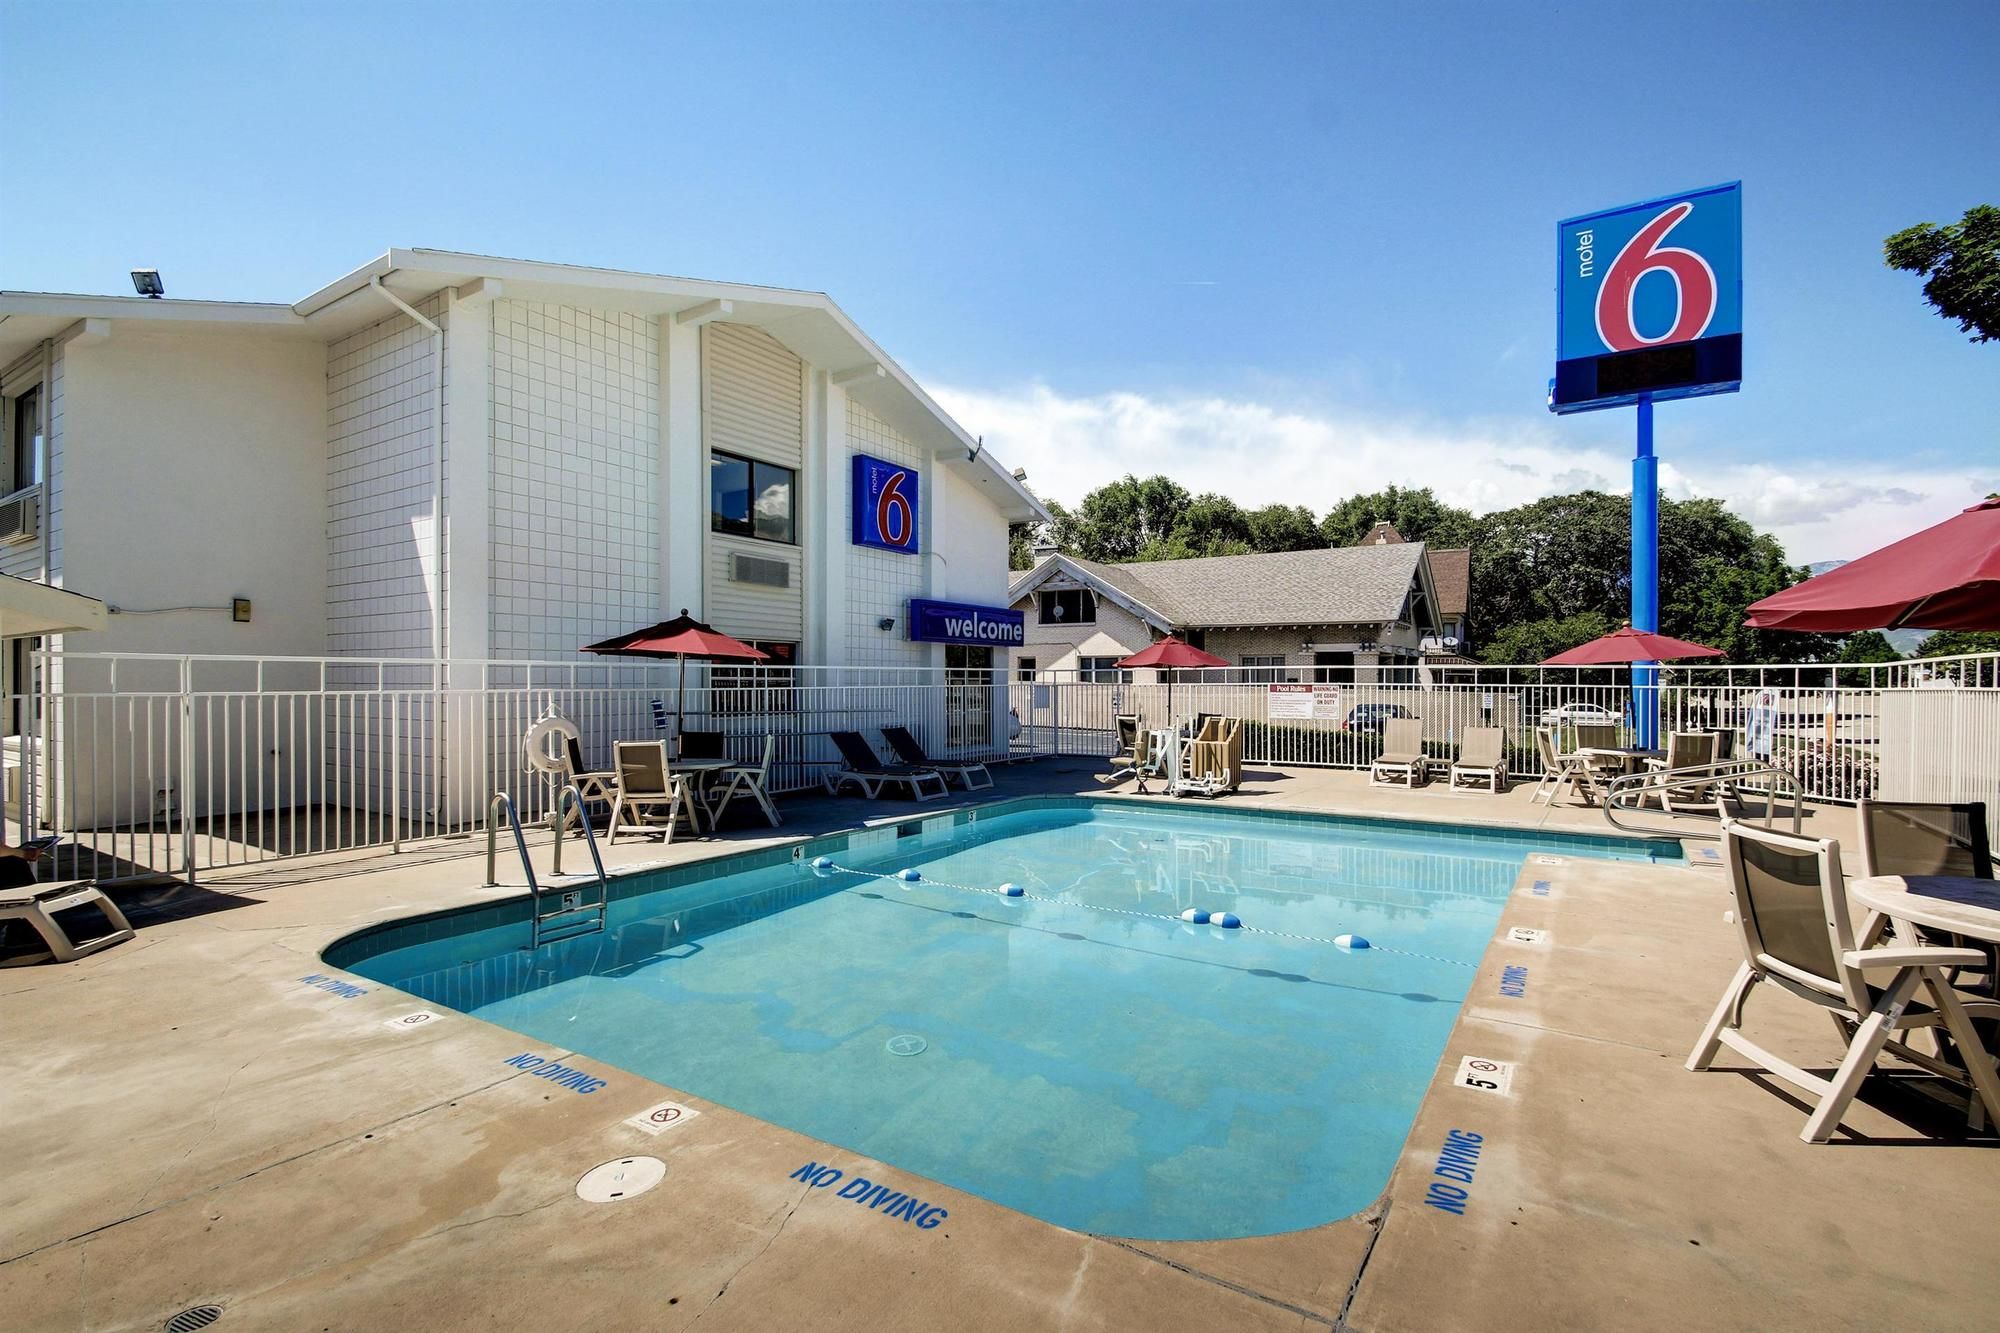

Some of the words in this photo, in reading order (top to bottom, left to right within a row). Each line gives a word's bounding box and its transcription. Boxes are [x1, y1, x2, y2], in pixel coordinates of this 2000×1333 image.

[1576, 229, 1593, 278] motel
[1594, 201, 1717, 352] 6
[877, 471, 912, 546] 6
[945, 612, 1023, 641] welcome
[794, 847, 800, 859] 4
[563, 893, 573, 905] 5
[503, 1053, 545, 1069] NO
[531, 1063, 607, 1094] DIVING
[1466, 1078, 1498, 1089] 5
[1434, 1129, 1483, 1183] DIVING
[789, 1161, 843, 1187] NO
[836, 1178, 948, 1229] DIVING
[1424, 1183, 1468, 1215] NO
